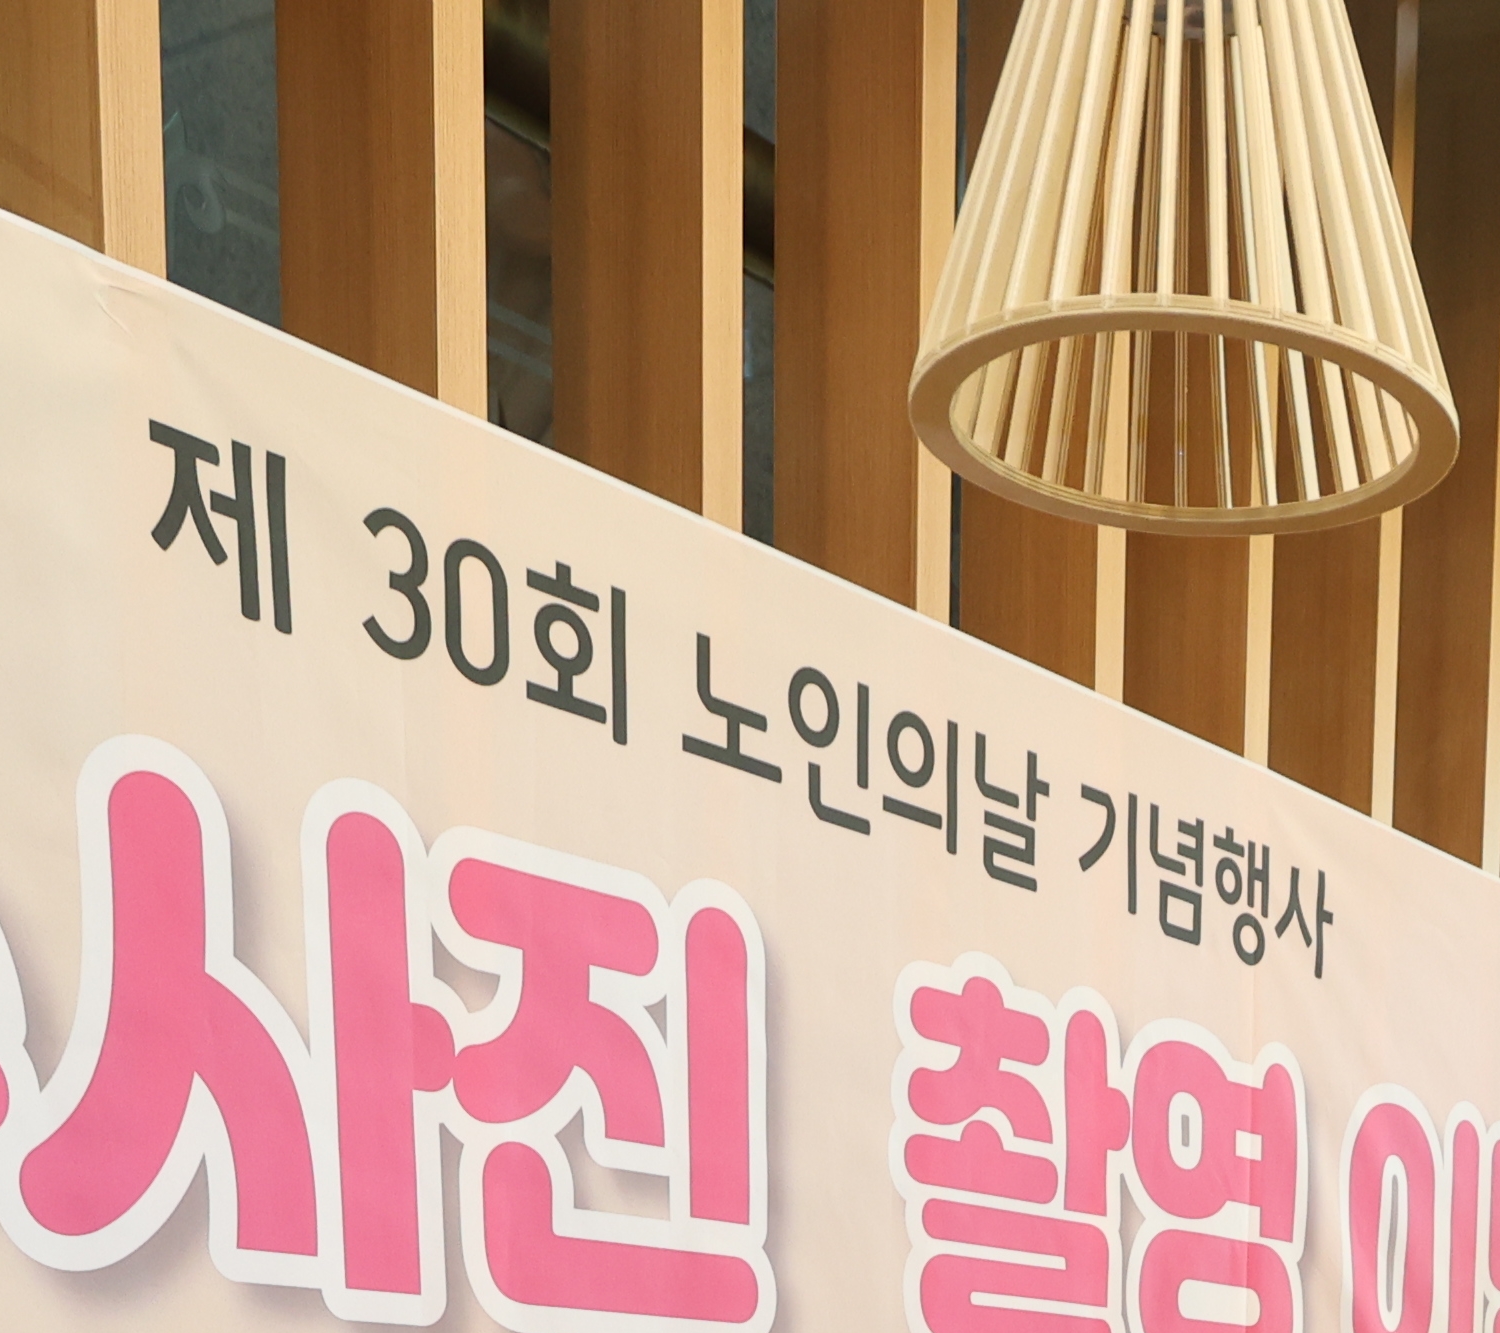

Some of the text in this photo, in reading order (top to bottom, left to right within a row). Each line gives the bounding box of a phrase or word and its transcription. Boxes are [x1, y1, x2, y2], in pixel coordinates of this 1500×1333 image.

[148, 417, 1334, 979] 제 30회 노인의날 기념행사
